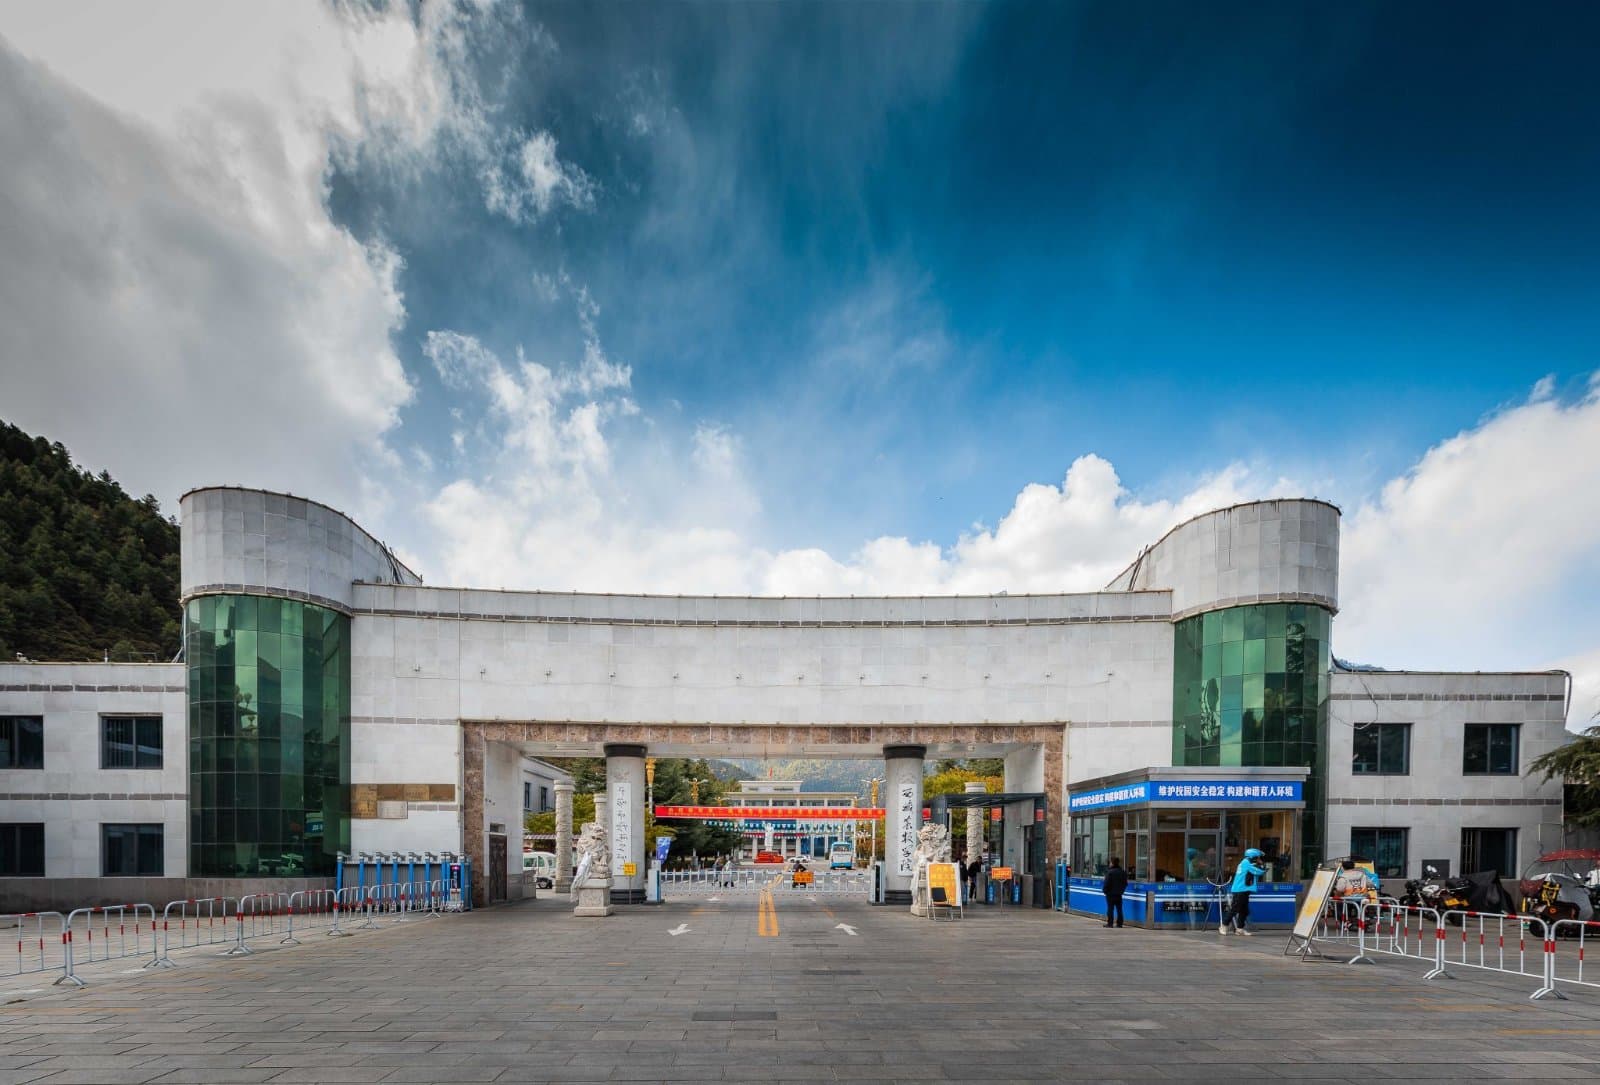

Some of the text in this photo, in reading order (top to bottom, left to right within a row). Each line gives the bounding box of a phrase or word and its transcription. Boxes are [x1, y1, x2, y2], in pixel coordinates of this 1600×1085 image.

[1158, 785, 1294, 797] 维护校园安全稳定 构建和谐育人环境
